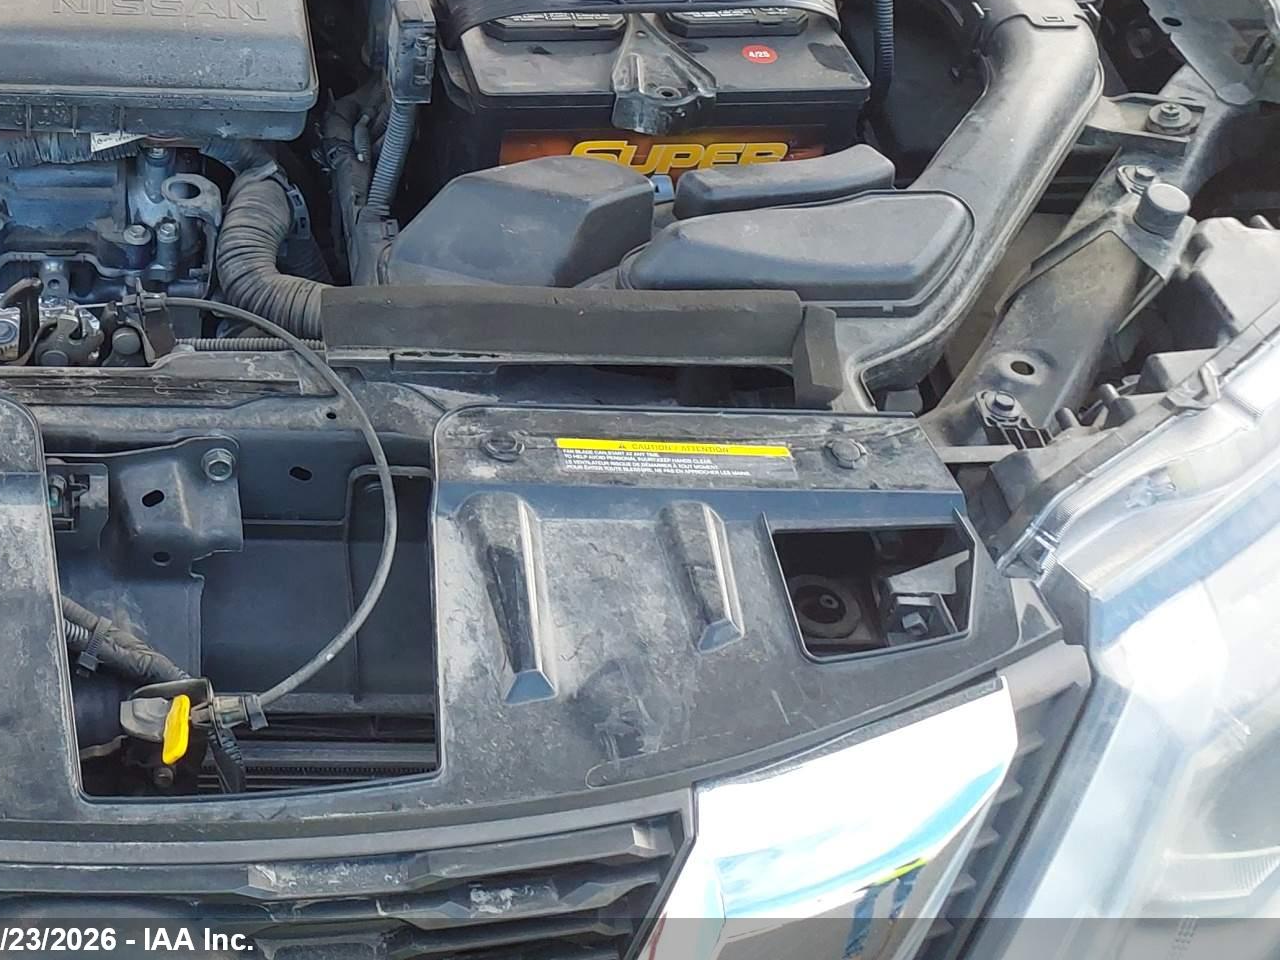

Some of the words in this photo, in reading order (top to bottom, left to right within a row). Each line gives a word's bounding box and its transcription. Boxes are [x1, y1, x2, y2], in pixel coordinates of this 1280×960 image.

[571, 140, 789, 175] SUPER
[631, 443, 671, 451] CAUTION
[681, 445, 729, 453] ATTENTION
